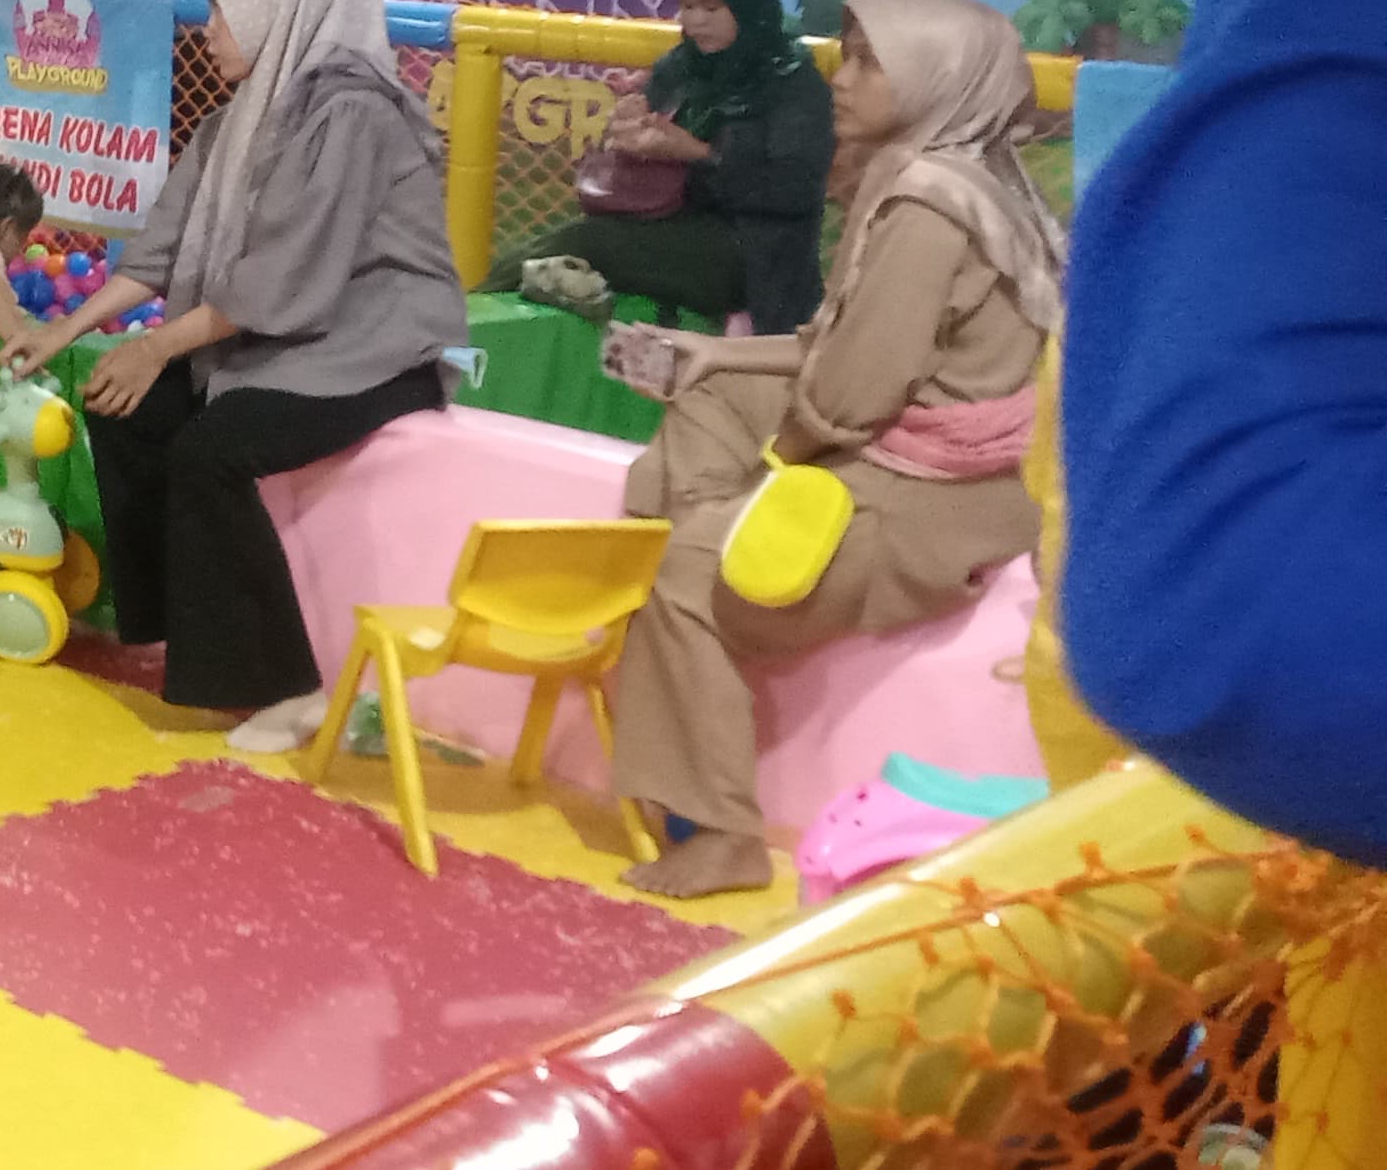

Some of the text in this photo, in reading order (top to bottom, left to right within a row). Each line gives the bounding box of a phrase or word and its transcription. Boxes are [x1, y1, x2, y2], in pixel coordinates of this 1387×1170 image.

[5, 53, 109, 91] PLAYGROUND
[59, 115, 159, 163] KOLAM
[68, 168, 139, 214] BOLA
